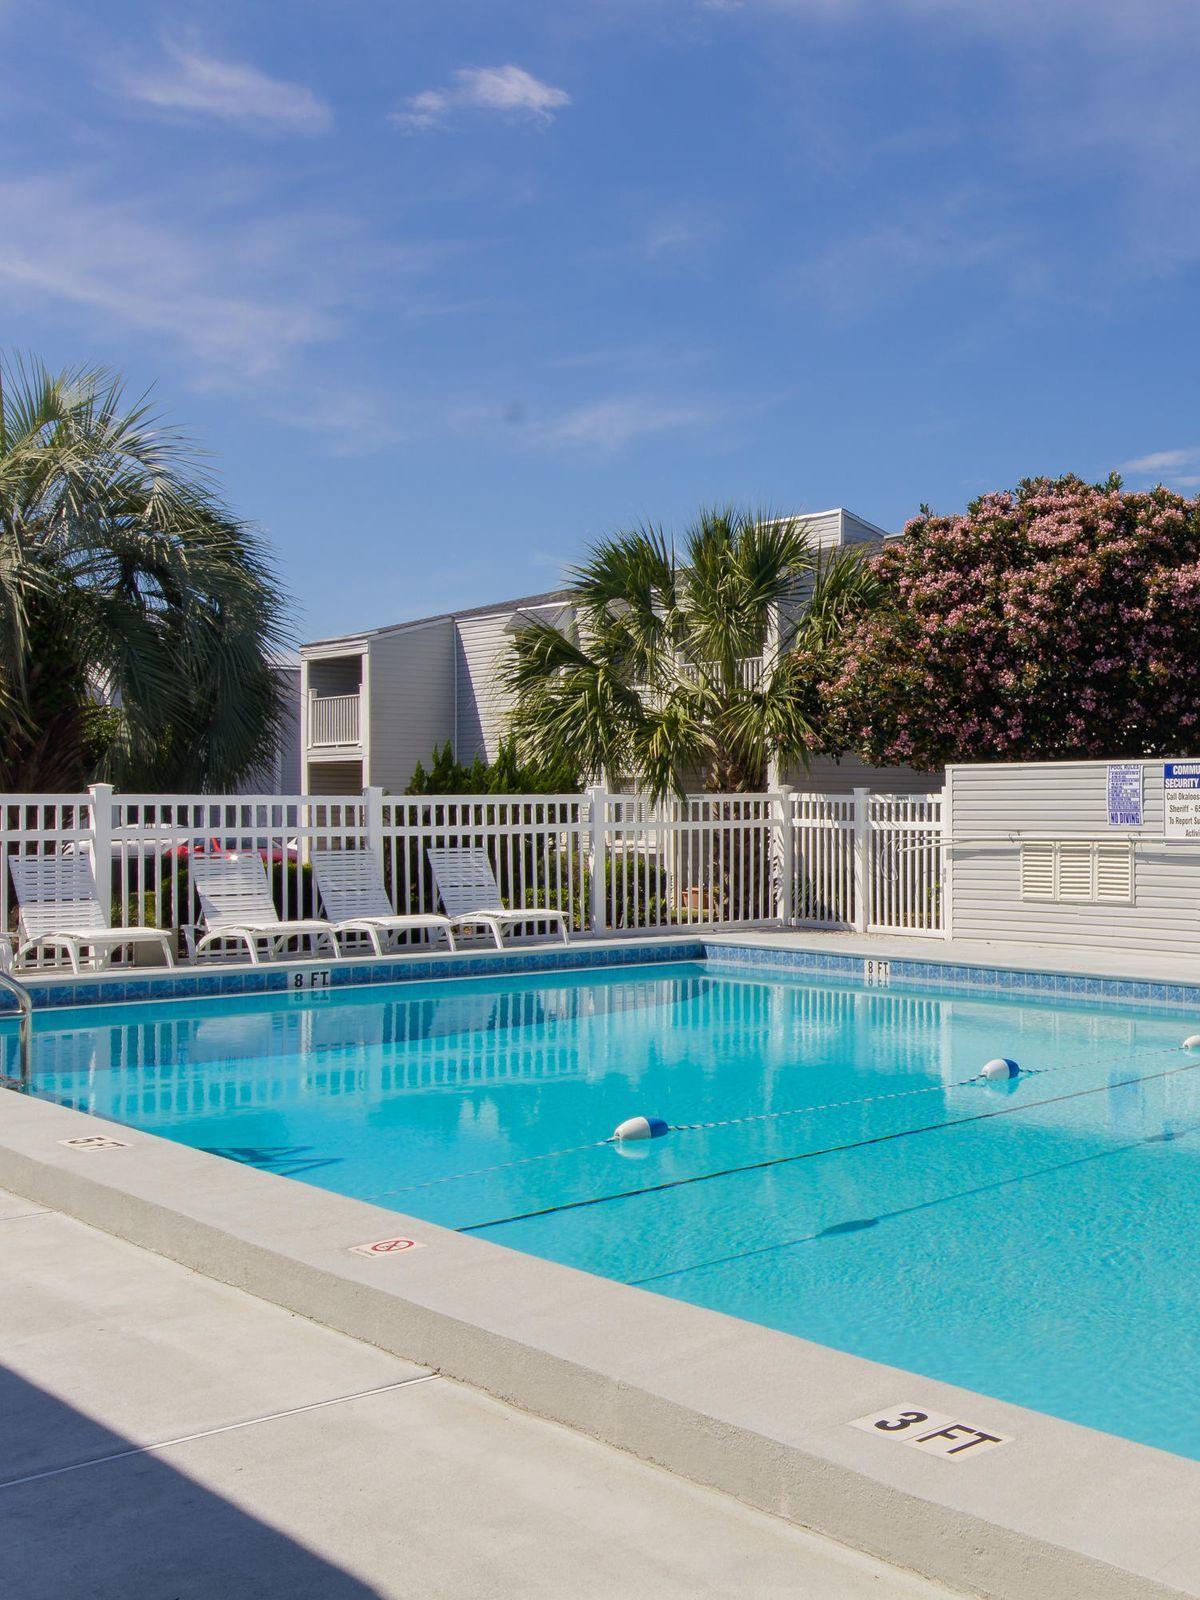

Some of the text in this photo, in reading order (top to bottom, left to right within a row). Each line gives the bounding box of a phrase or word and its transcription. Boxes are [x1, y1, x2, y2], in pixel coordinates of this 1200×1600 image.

[1165, 778, 1199, 788] SECURITY
[1166, 792, 1177, 801] Call
[1169, 805, 1189, 813] Sheriff
[1110, 812, 1140, 824] NO DIVING
[1169, 817, 1175, 825] To
[1176, 817, 1193, 827] Report
[867, 961, 874, 973] 8
[294, 973, 303, 987] 8
[874, 1411, 1003, 1455] 3 FT
